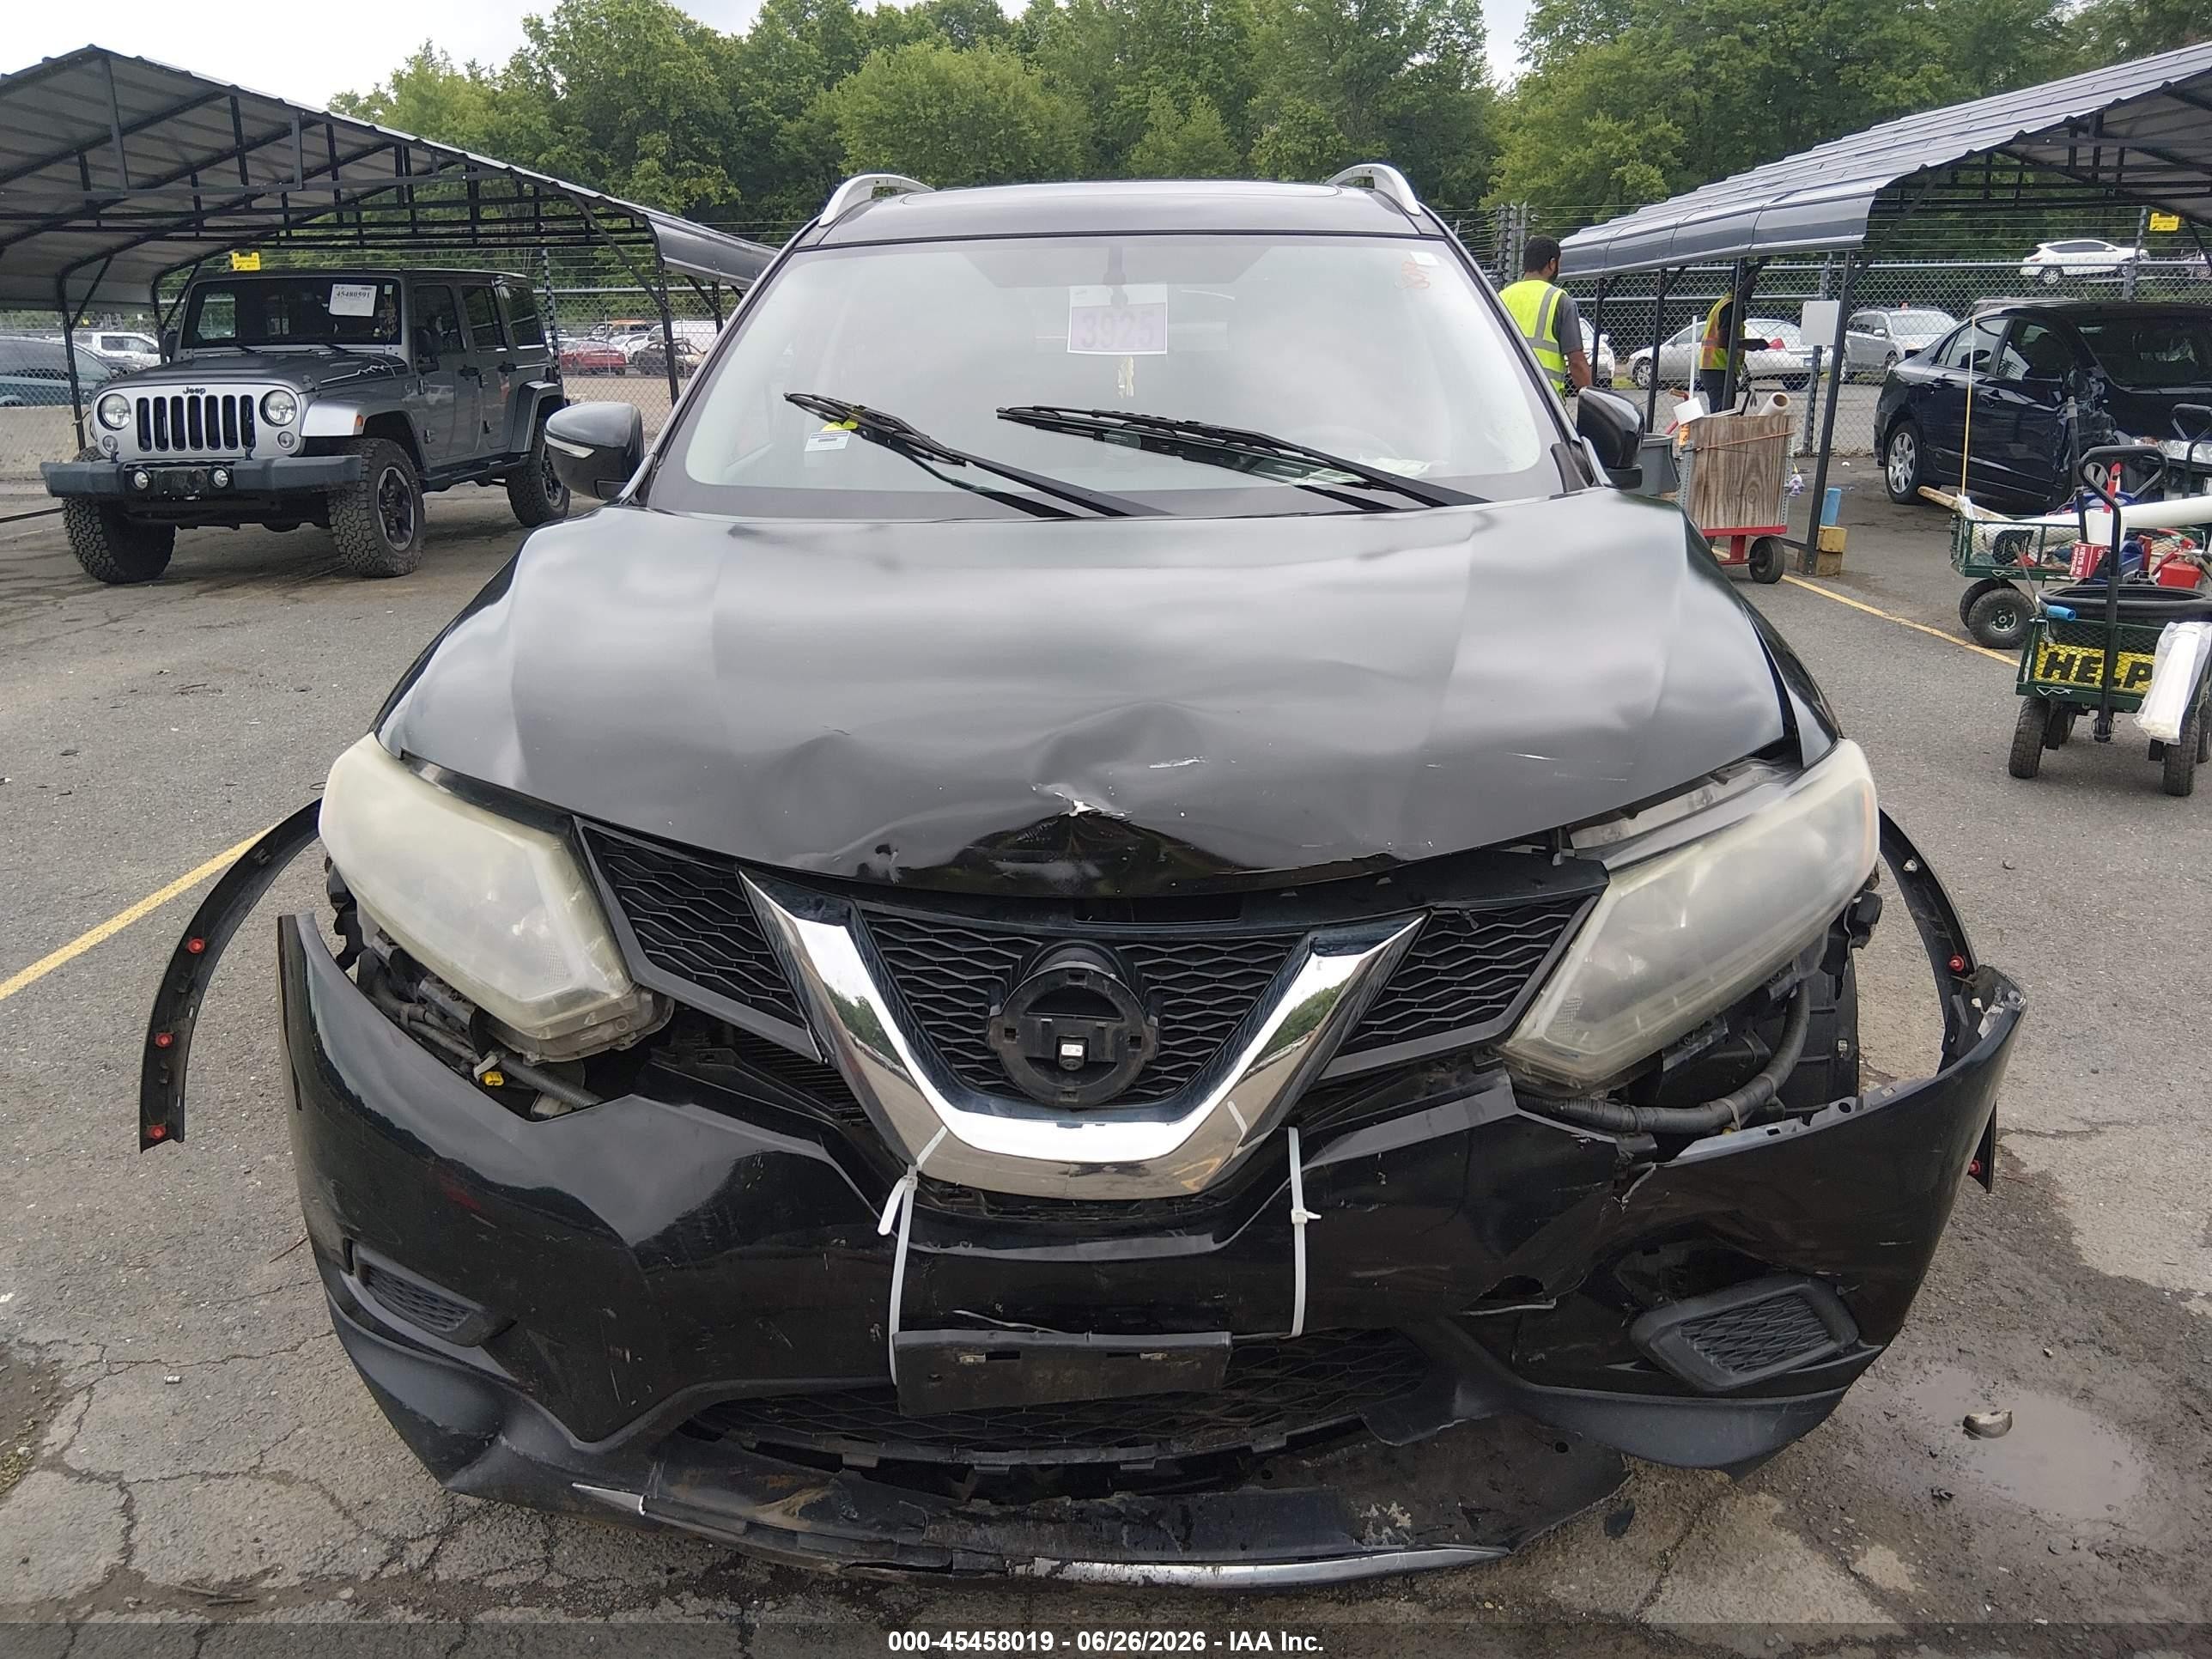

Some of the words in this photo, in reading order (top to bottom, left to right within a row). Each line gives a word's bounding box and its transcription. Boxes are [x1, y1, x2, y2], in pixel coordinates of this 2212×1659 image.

[1080, 310, 1154, 348] 3925
[183, 386, 206, 395] Jeep
[2077, 546, 2087, 565] KEYS
